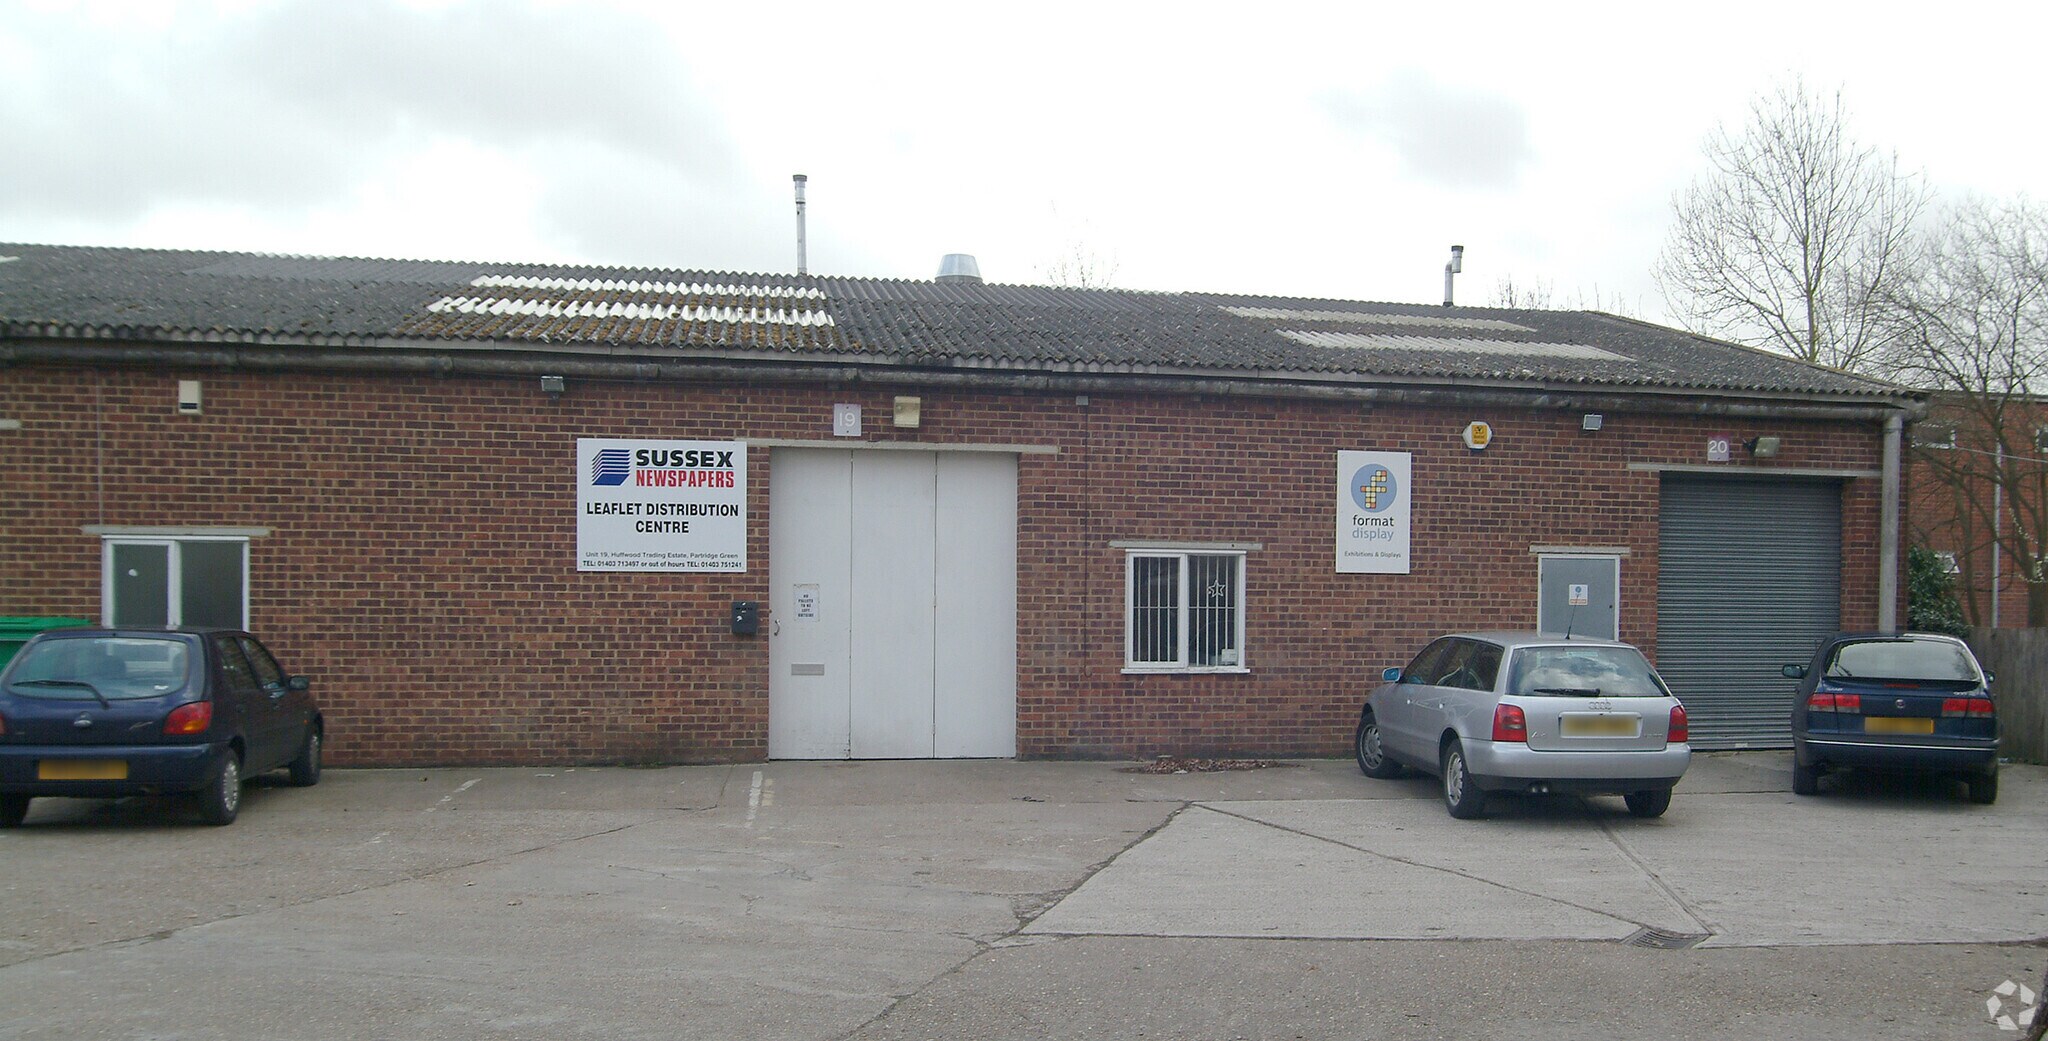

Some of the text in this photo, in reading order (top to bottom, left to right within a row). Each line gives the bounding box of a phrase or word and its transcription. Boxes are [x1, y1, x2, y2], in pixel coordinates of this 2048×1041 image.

[839, 412, 856, 427] 19
[1709, 440, 1728, 454] 20
[635, 449, 734, 468] SUSSEX
[636, 469, 735, 488] NEWSPAPERS
[586, 502, 739, 517] LEAFLET DISTRIBUTION
[635, 520, 690, 534] CENTRE
[1353, 515, 1395, 527] format
[1352, 527, 1394, 541] display
[642, 551, 666, 559] Trading
[690, 552, 719, 560] Partridge
[1344, 550, 1374, 558] Exhibitions
[1380, 551, 1402, 559] Displays
